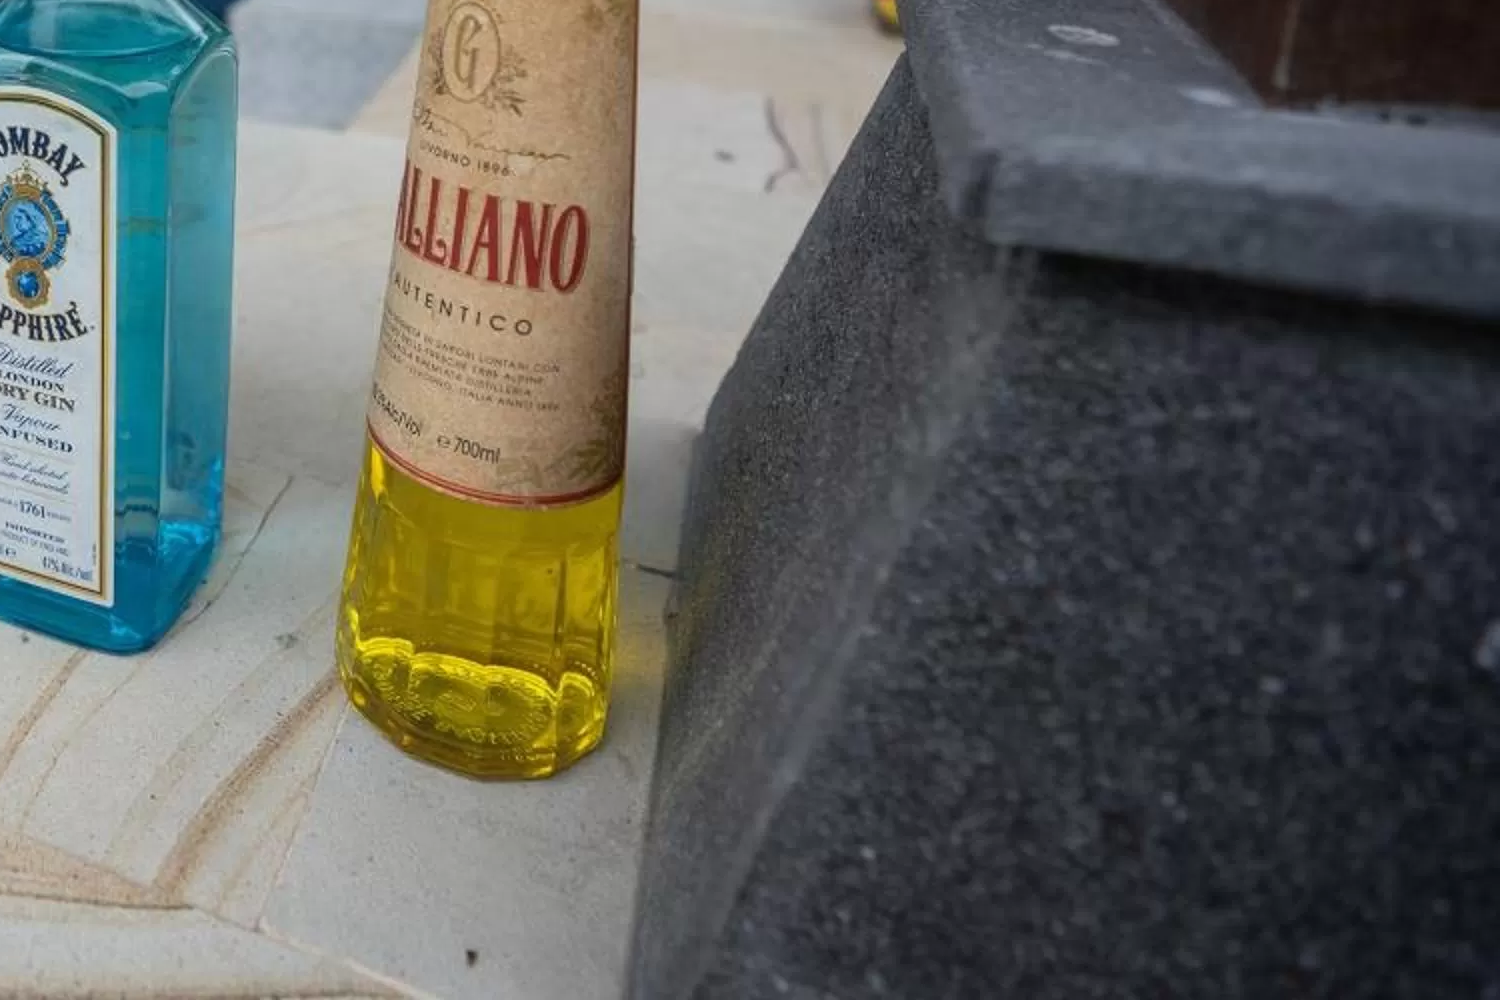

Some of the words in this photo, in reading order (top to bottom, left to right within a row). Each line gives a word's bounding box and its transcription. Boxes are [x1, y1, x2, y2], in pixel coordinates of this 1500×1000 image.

[34, 391, 75, 413] GIN
[453, 436, 500, 464] 700ml
[20, 500, 45, 519] 1761
